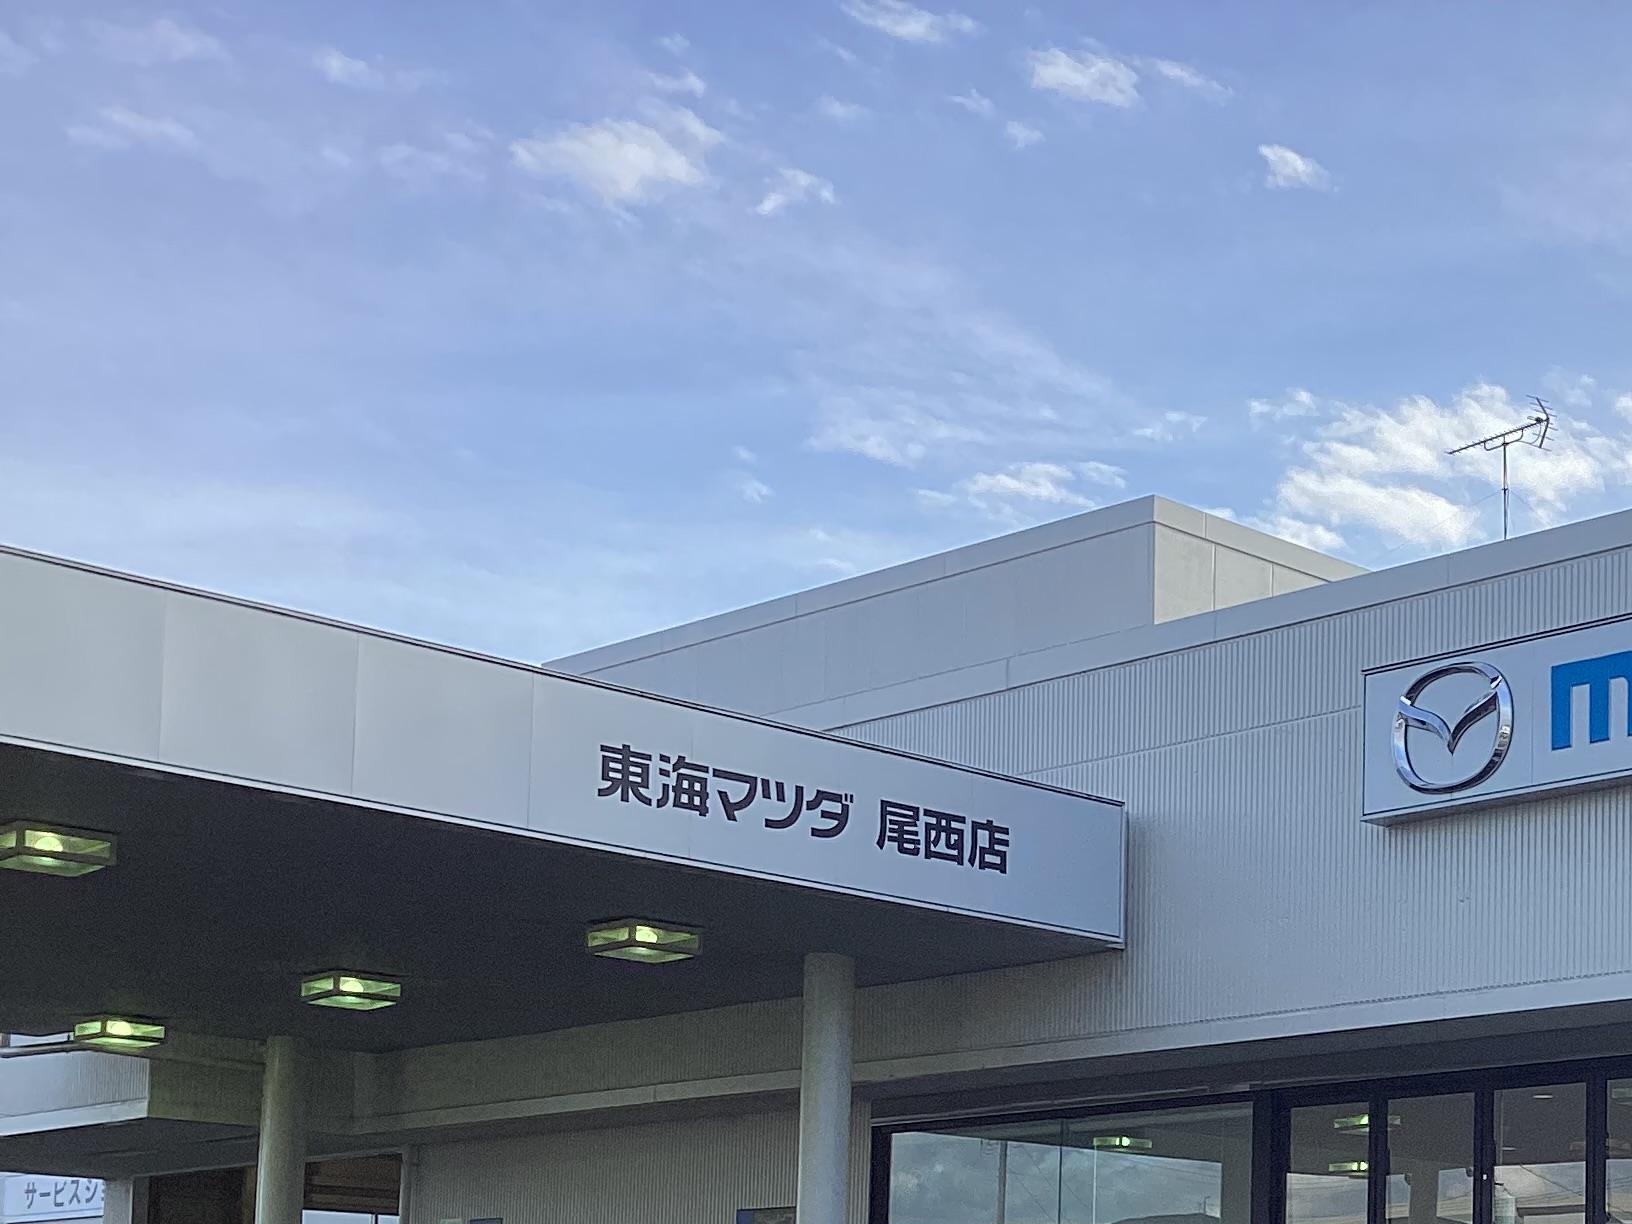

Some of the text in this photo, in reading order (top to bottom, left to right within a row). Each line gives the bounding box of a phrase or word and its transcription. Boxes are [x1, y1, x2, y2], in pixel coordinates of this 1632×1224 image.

[598, 743, 1010, 874] 東海マツダ 尾西店
